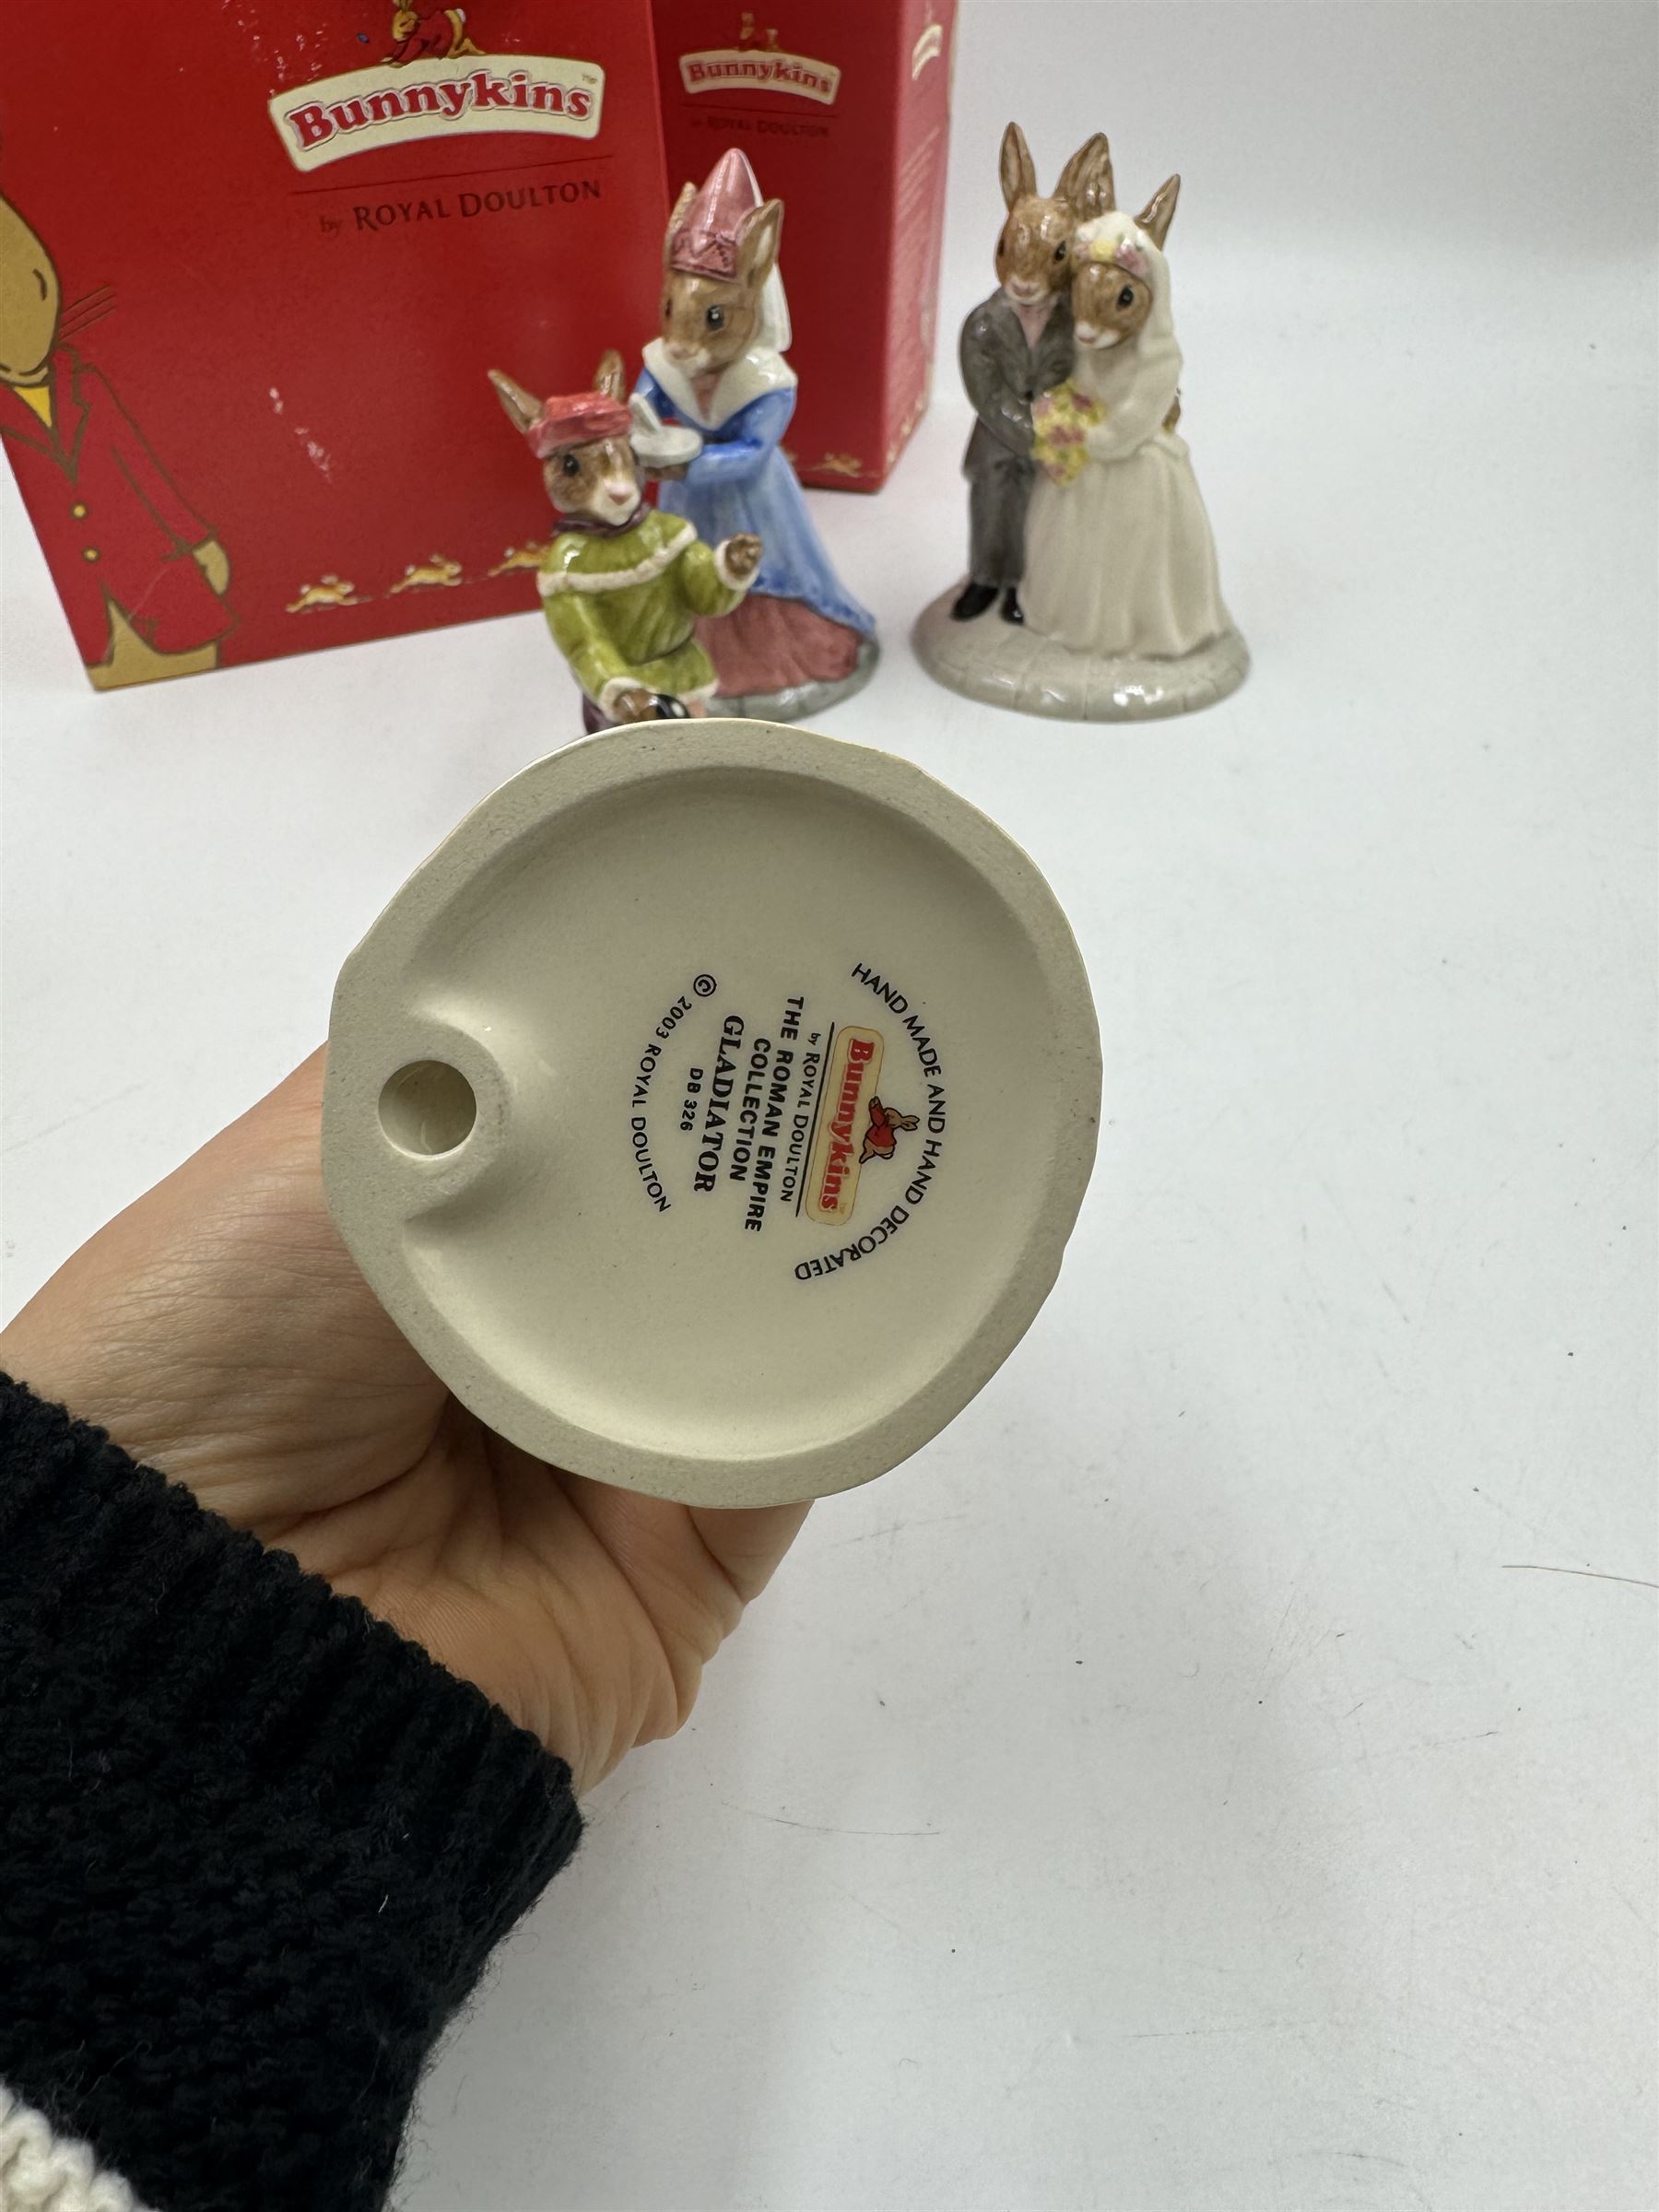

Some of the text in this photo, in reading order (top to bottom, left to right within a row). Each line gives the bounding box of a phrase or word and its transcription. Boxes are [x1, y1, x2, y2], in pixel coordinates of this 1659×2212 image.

[286, 70, 593, 150] Bunnykins
[688, 60, 831, 92] Bunnykins
[320, 180, 602, 237] by ROYAL DOULTON
[655, 995, 692, 1040] 2003
[631, 1043, 663, 1108] ROYAL
[679, 1067, 704, 1132] DB 326
[693, 1015, 745, 1192] GLADIATOR
[729, 1038, 771, 1182] COLLECTION
[744, 996, 805, 1232] THE ROMAN EMPIRE
[780, 1031, 821, 1203] by ROYAL DOULTON
[795, 962, 946, 1280] HAND MADE AND HAND DECORATED
[631, 1116, 672, 1213] DOULTON
[819, 1039, 876, 1212] Bunnykins
